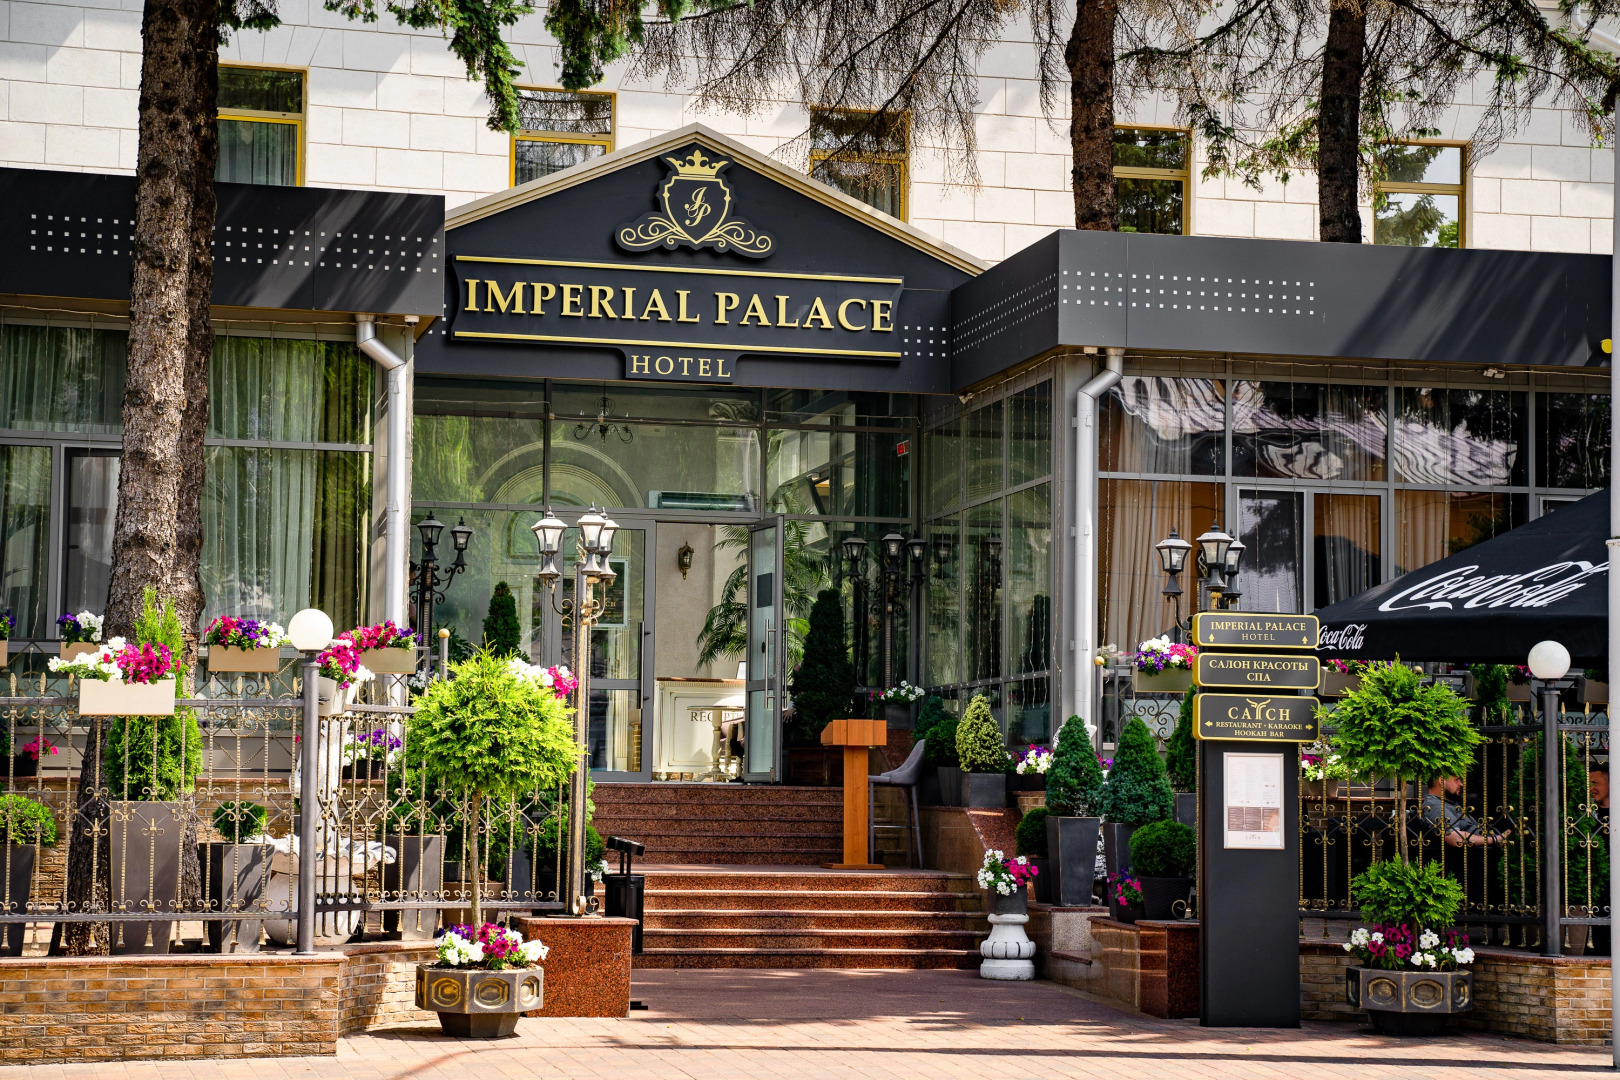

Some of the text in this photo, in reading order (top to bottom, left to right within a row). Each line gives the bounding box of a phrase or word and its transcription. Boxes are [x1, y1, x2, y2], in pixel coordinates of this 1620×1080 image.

[464, 277, 895, 332] IMPERIAL PALACE
[630, 354, 732, 378] HOTEL
[1378, 560, 1609, 612] Coca-Cola
[1210, 621, 1307, 632] IMPERIAL PALACE
[1241, 633, 1276, 641] HOTEL
[1209, 659, 1309, 671] САЛОН КРАСОТЫ
[1246, 672, 1272, 682] СПА
[1227, 698, 1291, 721] CATCH
[1215, 721, 1263, 729] RESTAURANT
